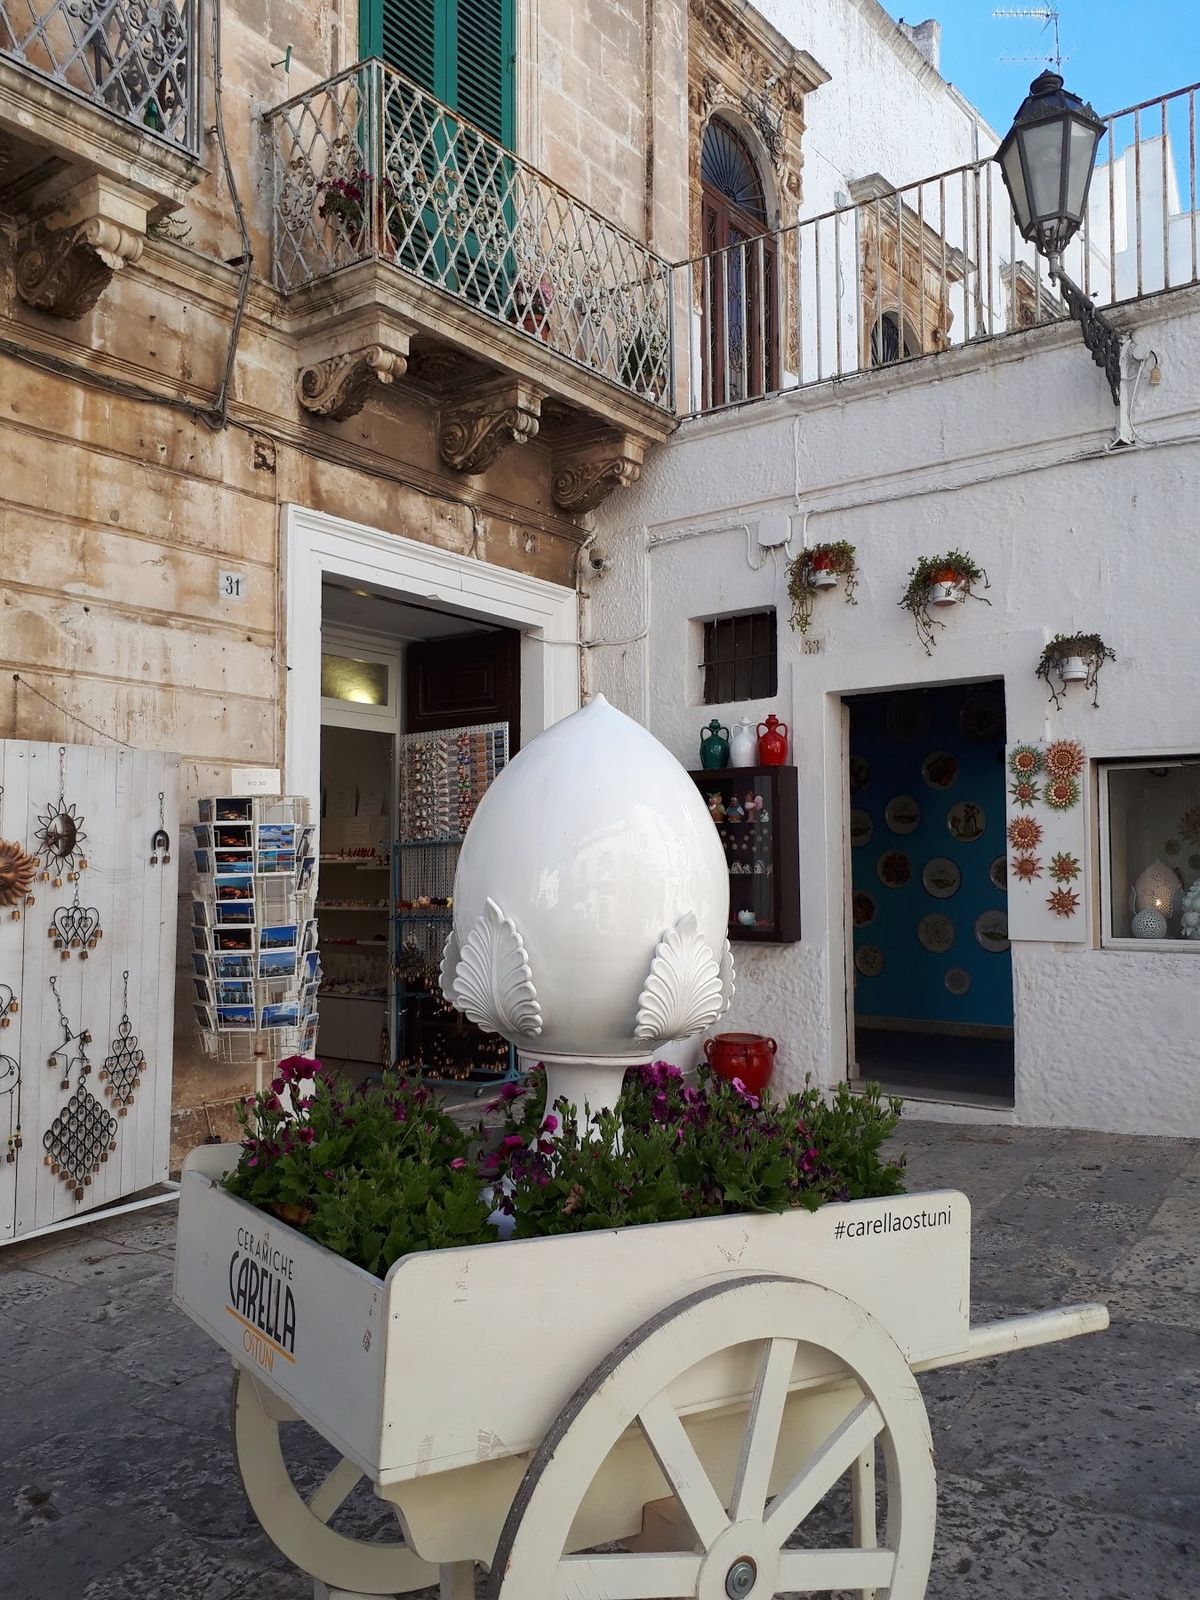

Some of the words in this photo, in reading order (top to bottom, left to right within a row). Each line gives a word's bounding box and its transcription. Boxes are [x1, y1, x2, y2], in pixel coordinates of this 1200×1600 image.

[225, 575, 240, 596] 31
[805, 640, 819, 655] 33
[834, 1205, 951, 1239] #carellaostuni
[237, 1227, 294, 1281] CERAMICHE
[229, 1250, 296, 1353] CARELLA
[243, 1329, 274, 1373] OSTUNI
